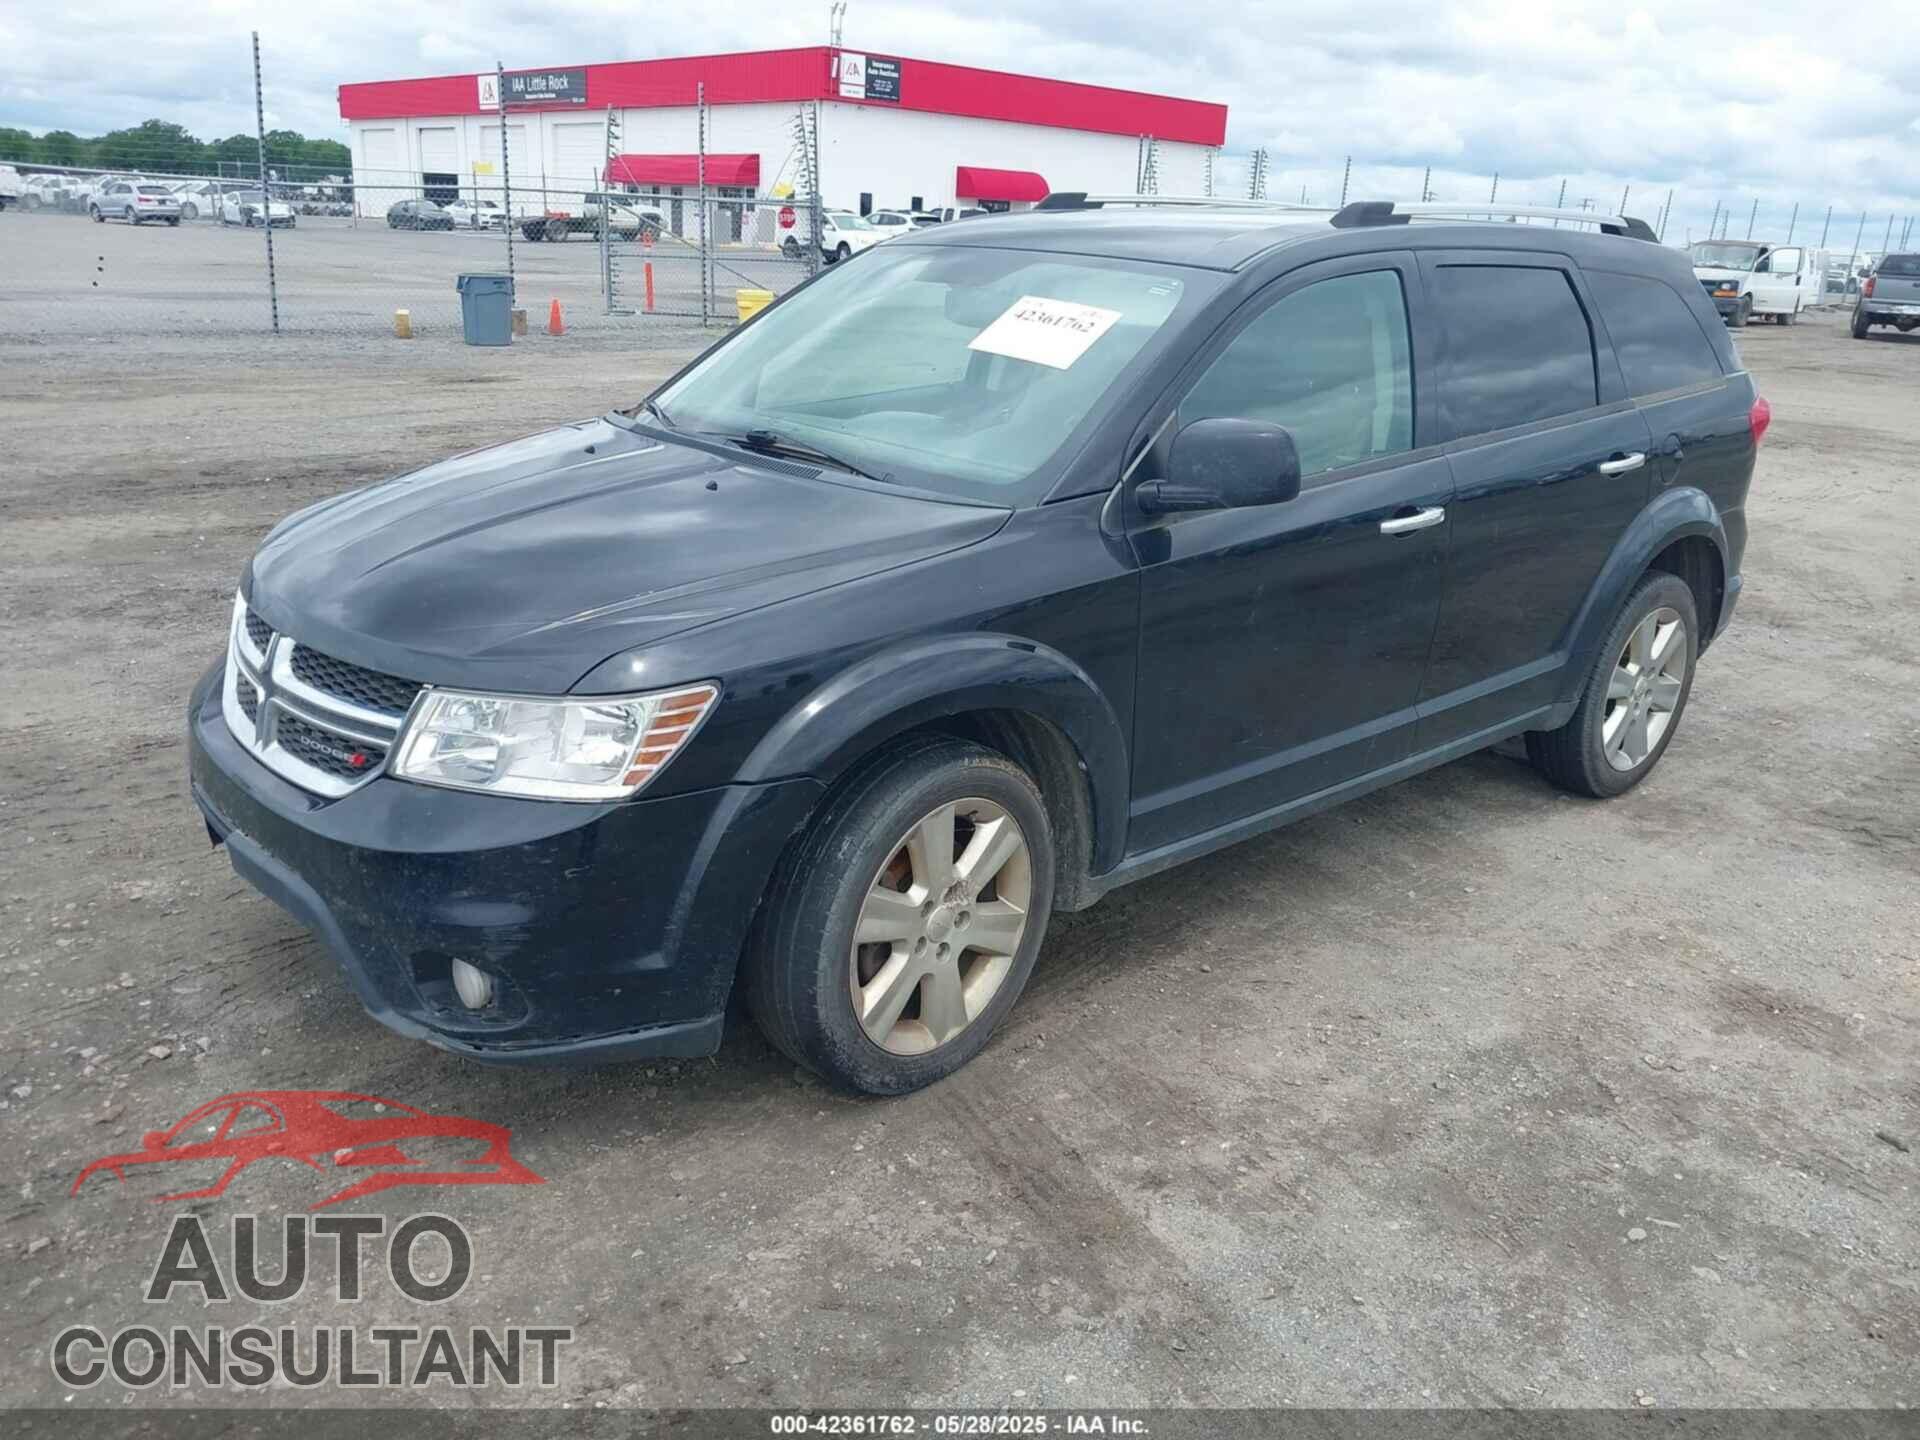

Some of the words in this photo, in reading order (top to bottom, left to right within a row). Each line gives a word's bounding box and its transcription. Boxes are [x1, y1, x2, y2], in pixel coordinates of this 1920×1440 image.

[512, 77, 524, 92] IAA
[526, 76, 546, 91] Little
[548, 73, 568, 89] Rock
[778, 213, 796, 222] STOP
[1014, 310, 1095, 333] 42361762
[301, 736, 355, 762] DODGE
